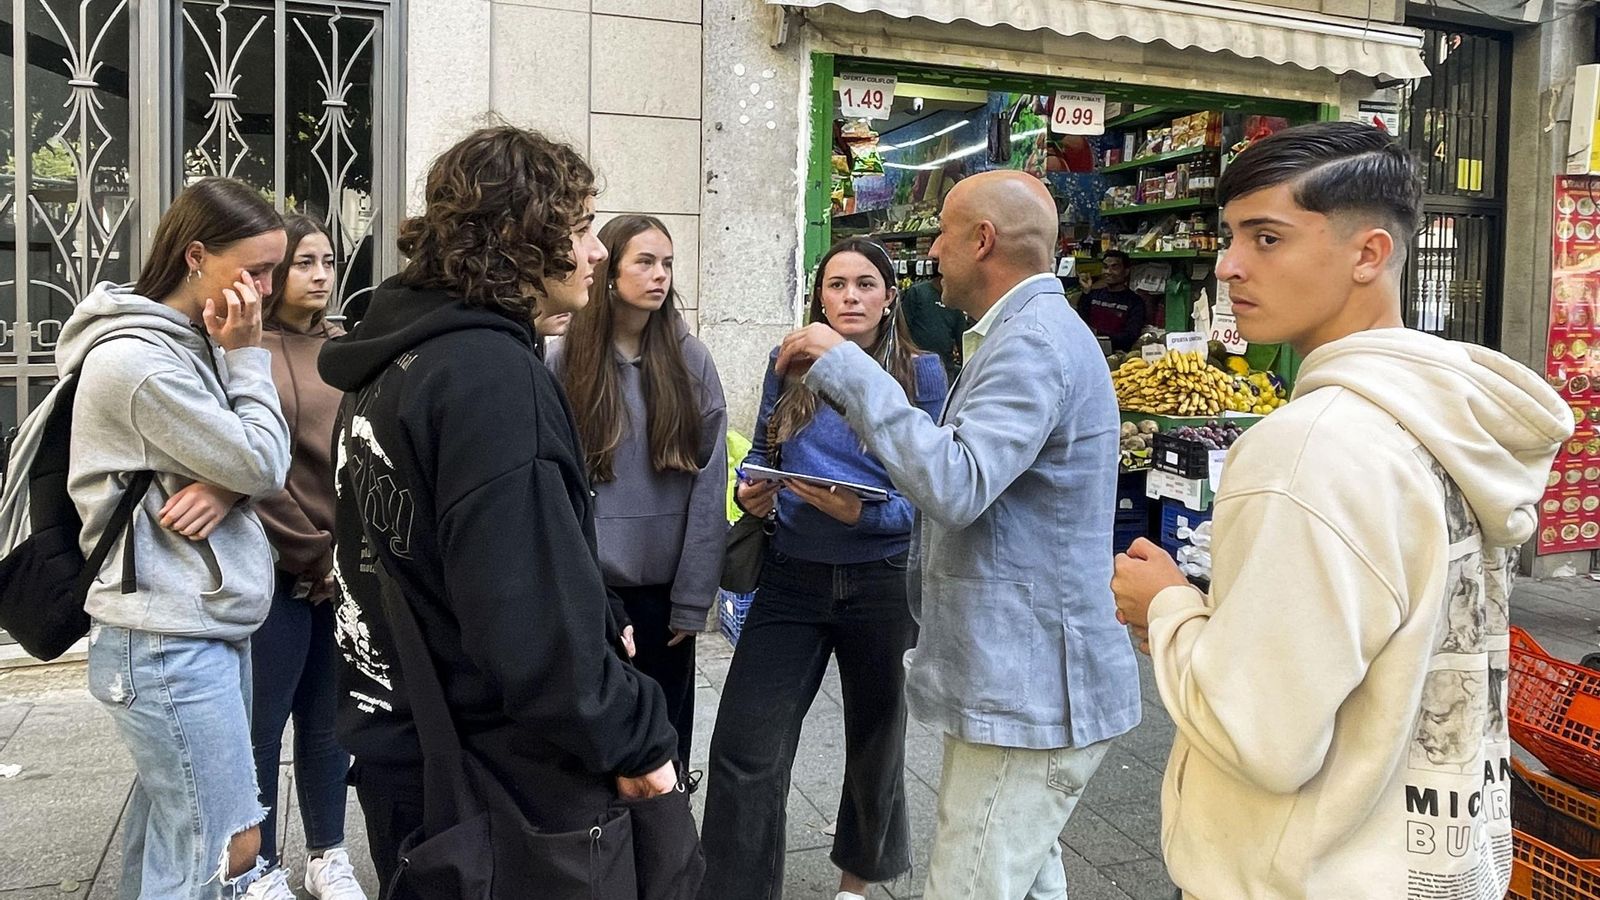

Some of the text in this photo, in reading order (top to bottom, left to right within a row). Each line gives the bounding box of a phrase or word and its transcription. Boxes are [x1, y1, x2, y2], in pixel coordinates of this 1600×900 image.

[842, 74, 866, 82] OFERTA
[843, 87, 883, 110] 1.49
[1055, 106, 1093, 126] 0.99
[1434, 141, 1445, 162] 4
